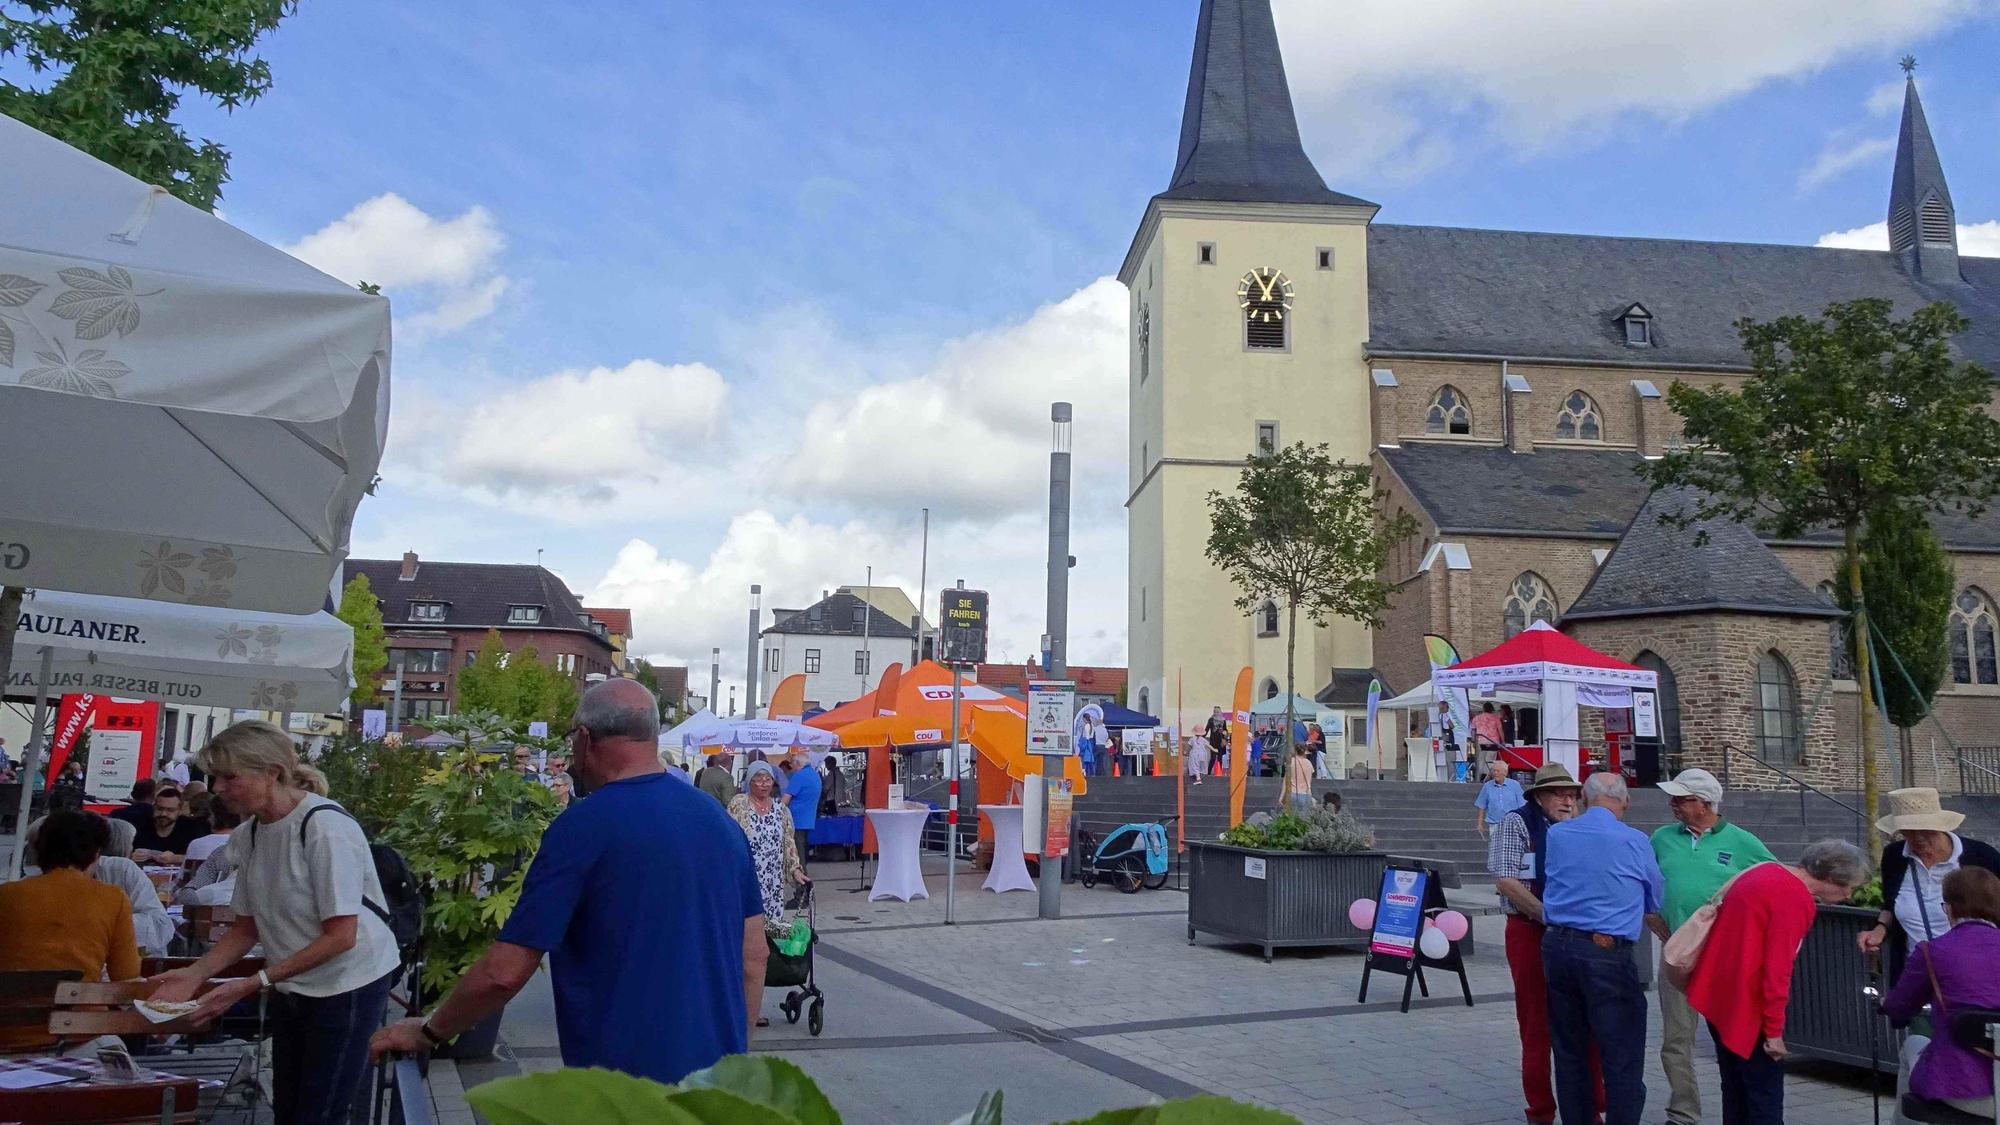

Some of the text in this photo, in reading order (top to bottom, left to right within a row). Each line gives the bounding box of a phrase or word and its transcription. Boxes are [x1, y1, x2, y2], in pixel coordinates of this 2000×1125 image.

[958, 599, 972, 608] SIE
[949, 609, 981, 620] FAHREN
[16, 613, 147, 644] AULANER.
